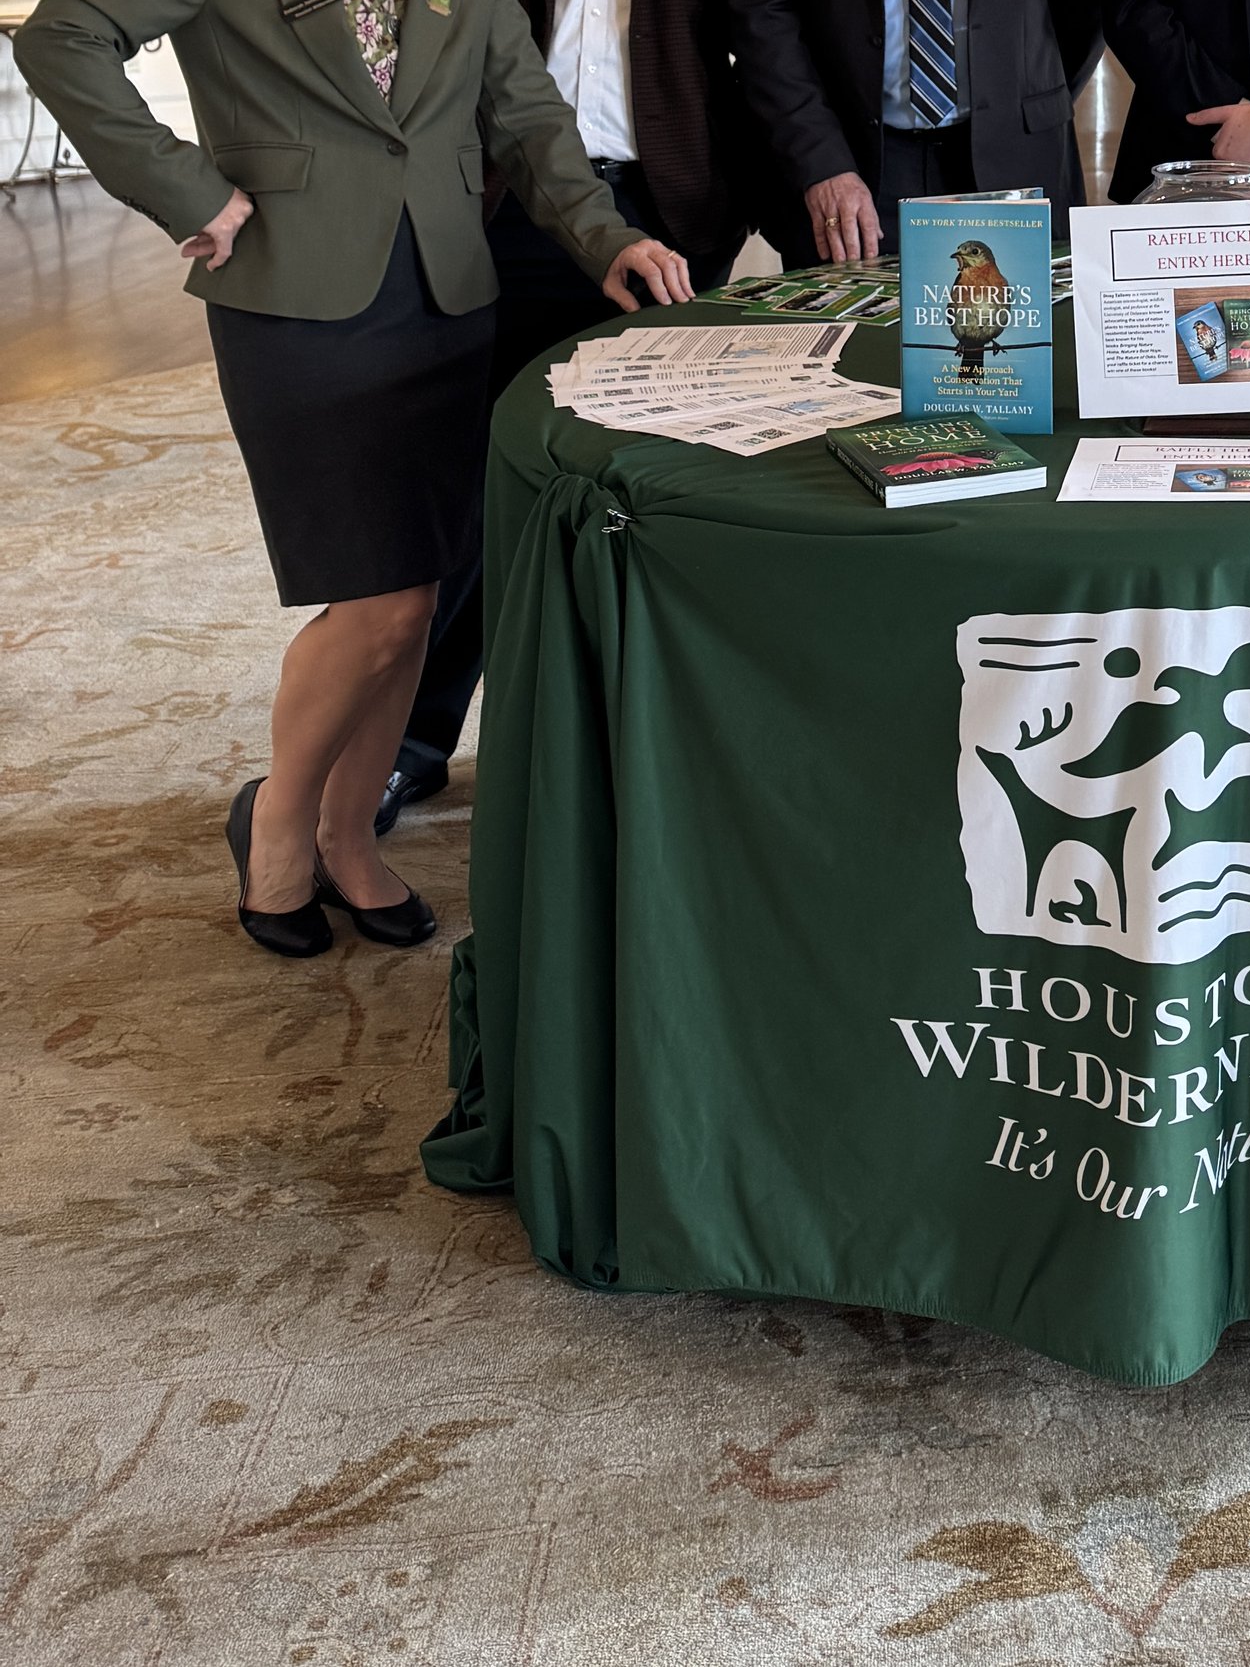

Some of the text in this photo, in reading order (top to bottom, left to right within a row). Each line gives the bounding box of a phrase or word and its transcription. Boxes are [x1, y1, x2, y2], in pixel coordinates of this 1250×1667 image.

[932, 219, 956, 227] YORK
[988, 220, 1043, 228] BESTSELLER
[1148, 232, 1207, 246] RAFFLE
[1158, 256, 1209, 270] ENTRY
[923, 284, 1032, 305] NATURE'S
[915, 307, 1042, 328] BEST HOPE
[951, 365, 971, 373] New
[973, 365, 1014, 375] Approach
[934, 376, 1023, 386] to Conservation That
[938, 387, 1018, 397] Starts in Your Yard
[924, 403, 1034, 415] DOUGLAS W. TALLAMY
[856, 420, 971, 438] BRINGING
[862, 425, 981, 444] NATURE
[867, 431, 986, 451] HOME
[894, 470, 952, 481] DOUGLAS
[971, 461, 1024, 470] TALLAMY
[986, 1116, 1056, 1180] It's
[1077, 1147, 1168, 1220] Our
